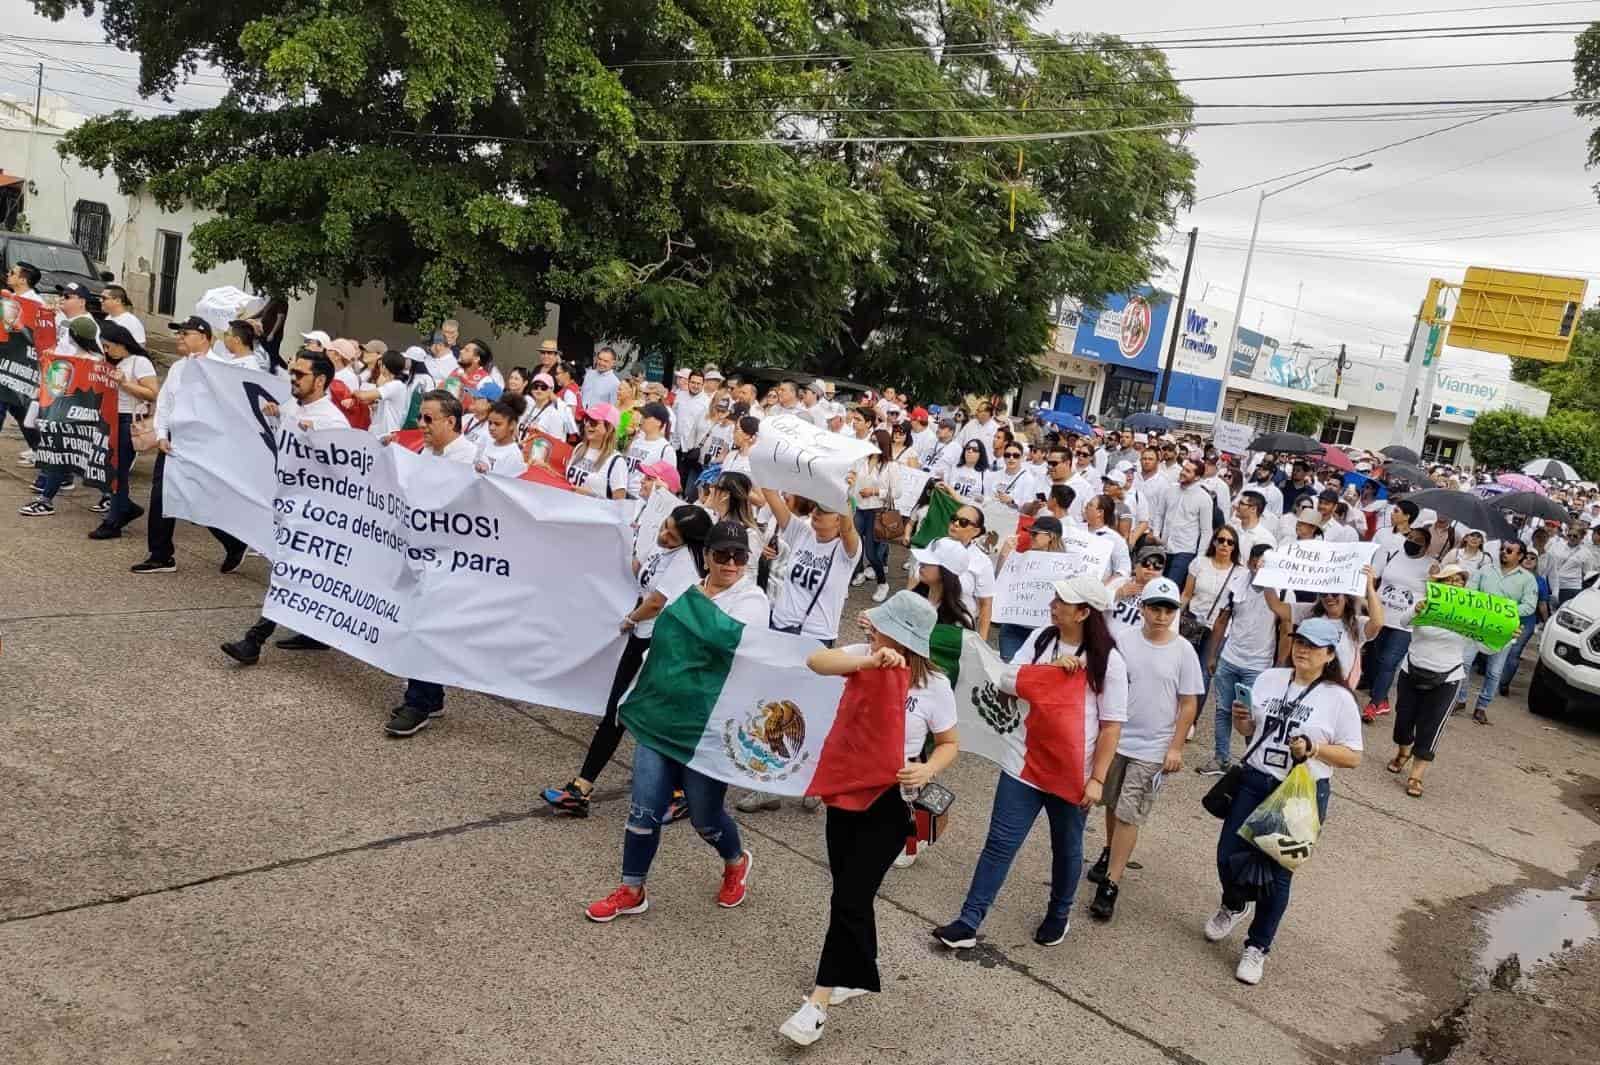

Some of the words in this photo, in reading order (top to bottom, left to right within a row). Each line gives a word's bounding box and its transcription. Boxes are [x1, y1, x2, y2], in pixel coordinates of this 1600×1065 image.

[1437, 373, 1498, 401] Vianney
[567, 467, 589, 487] PJF
[954, 483, 973, 496] PJF
[367, 485, 385, 511] tus
[302, 499, 348, 530] toca
[352, 515, 442, 568] defendeos,
[450, 550, 510, 577] para
[790, 563, 822, 590] PJF
[272, 560, 400, 623] OYPODERJUDICIAL
